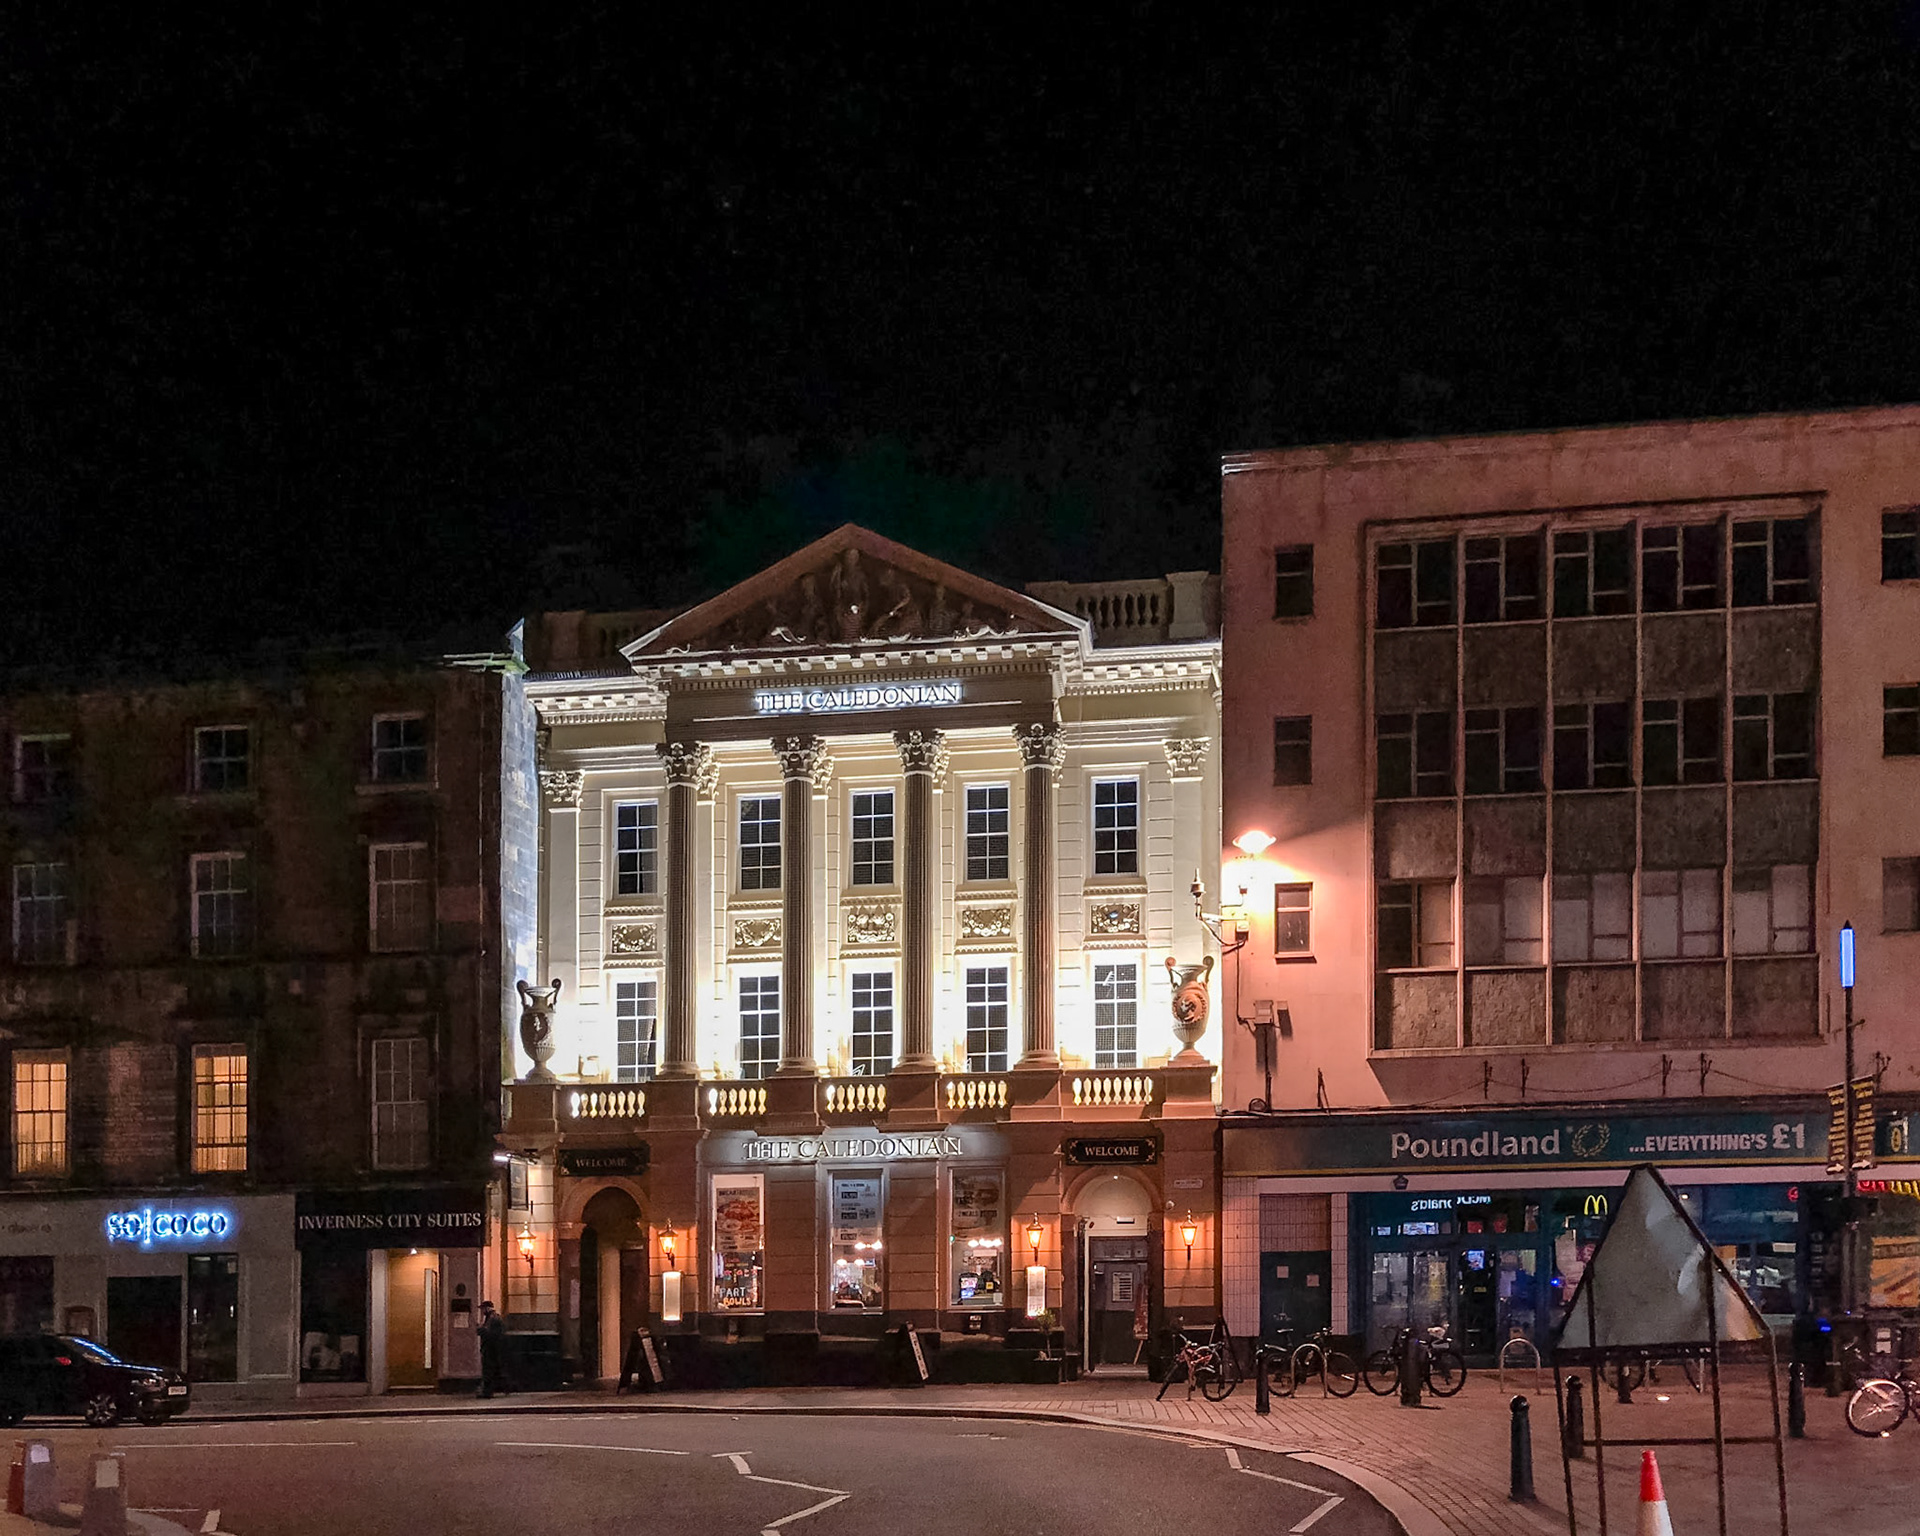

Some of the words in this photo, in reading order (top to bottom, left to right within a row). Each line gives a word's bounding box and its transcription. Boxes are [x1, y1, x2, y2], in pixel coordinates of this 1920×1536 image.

[756, 693, 801, 711] THE
[808, 684, 959, 709] CALEDONIAN
[1391, 1128, 1560, 1158] Poundland
[1772, 1123, 1806, 1150] £1
[742, 1141, 790, 1159] THE
[800, 1137, 963, 1158] CALEDONIAN
[1085, 1146, 1139, 1156] WELCOME
[575, 1158, 627, 1168] WELCOME
[153, 1213, 227, 1236] COCO
[300, 1215, 384, 1229] INVERNESS
[388, 1214, 421, 1228] CITY
[427, 1212, 482, 1228] SUITES
